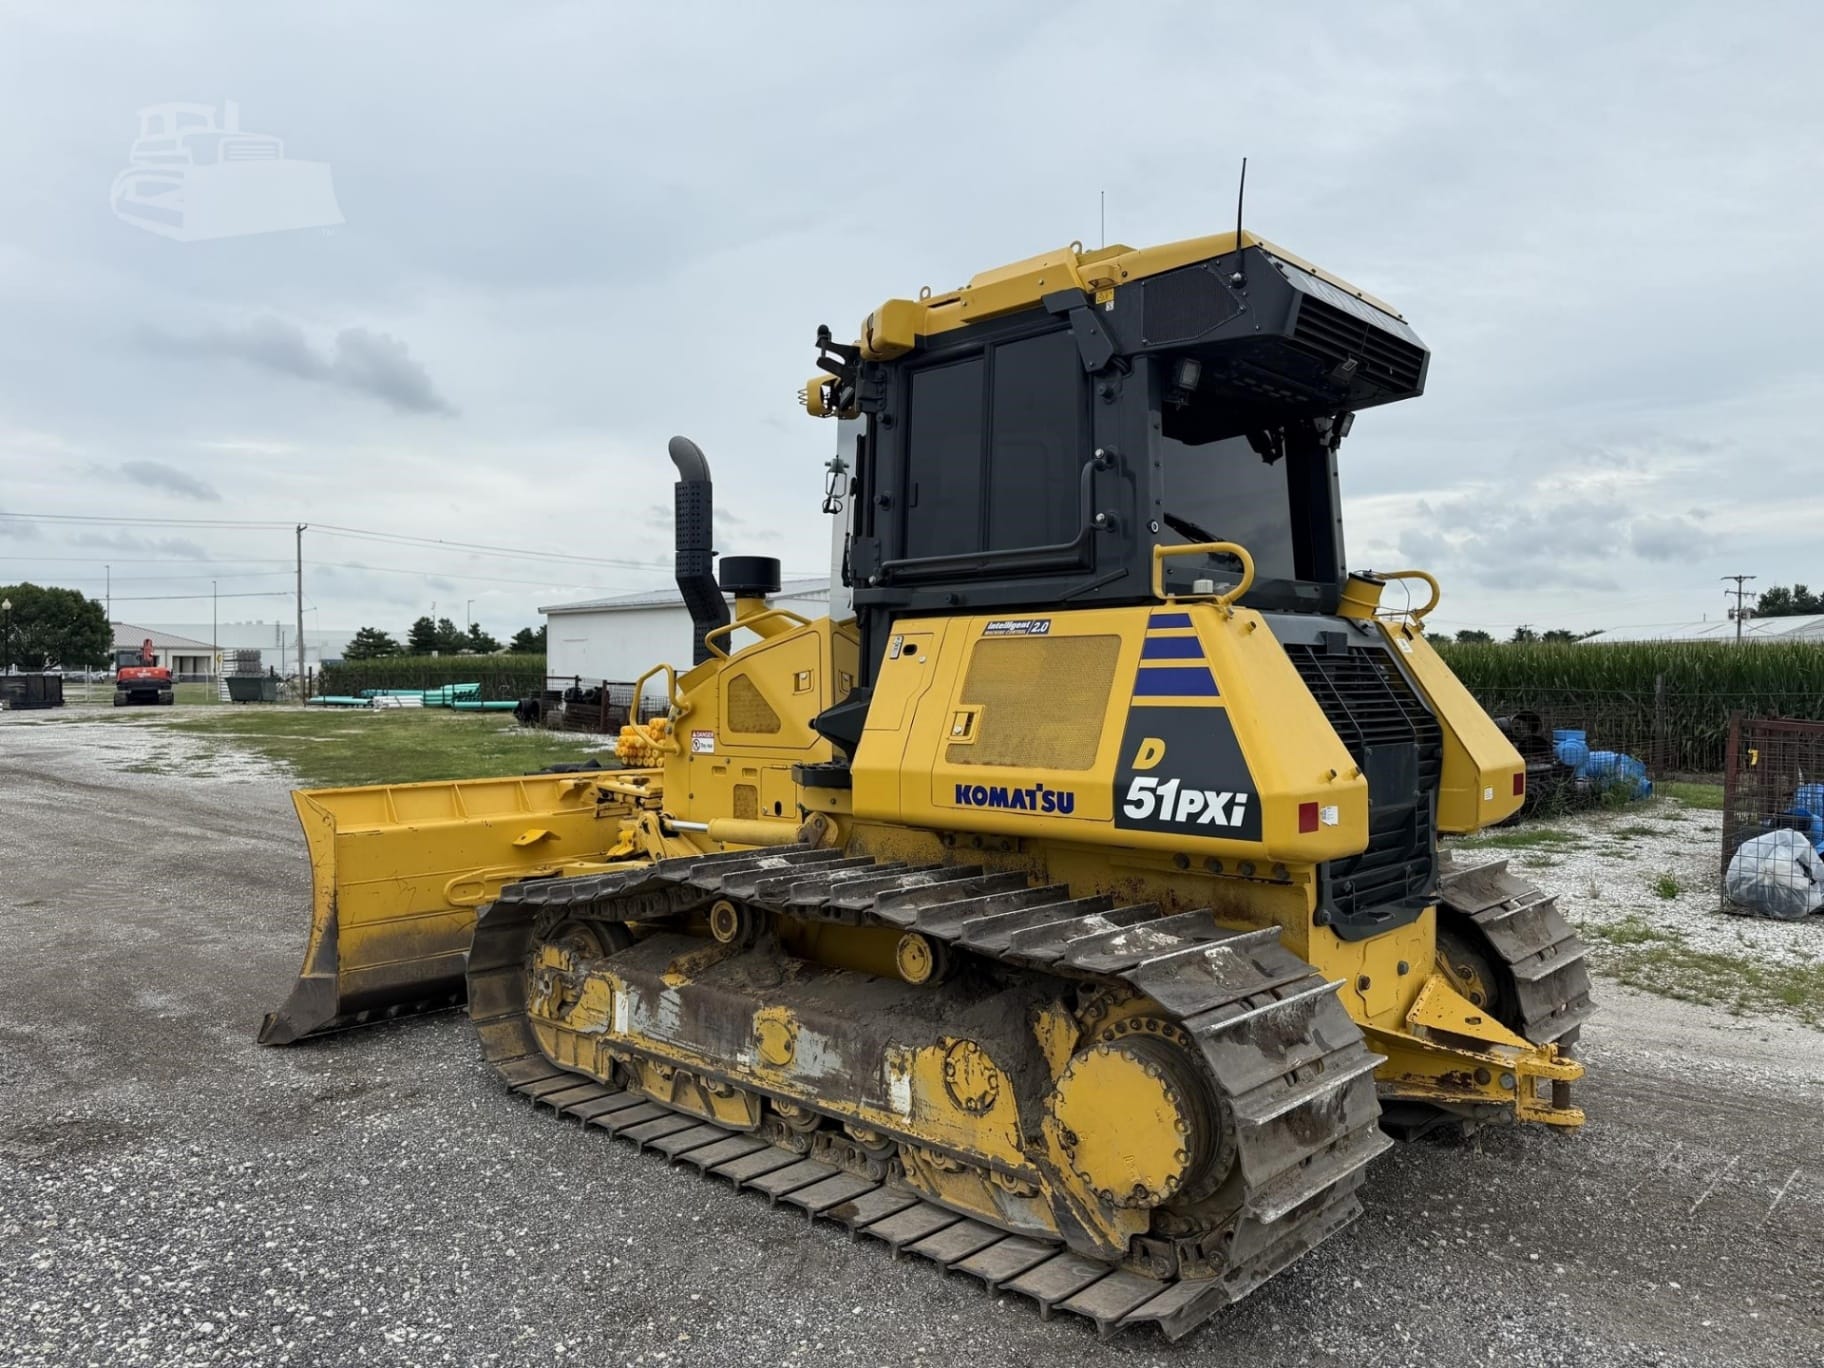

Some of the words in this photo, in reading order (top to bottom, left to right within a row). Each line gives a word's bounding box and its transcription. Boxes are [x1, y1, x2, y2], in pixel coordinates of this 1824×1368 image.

[1031, 621, 1050, 633] 2.0
[1131, 737, 1166, 770] D
[955, 783, 1075, 815] KOMATSU
[1123, 776, 1249, 827] 51PXi
